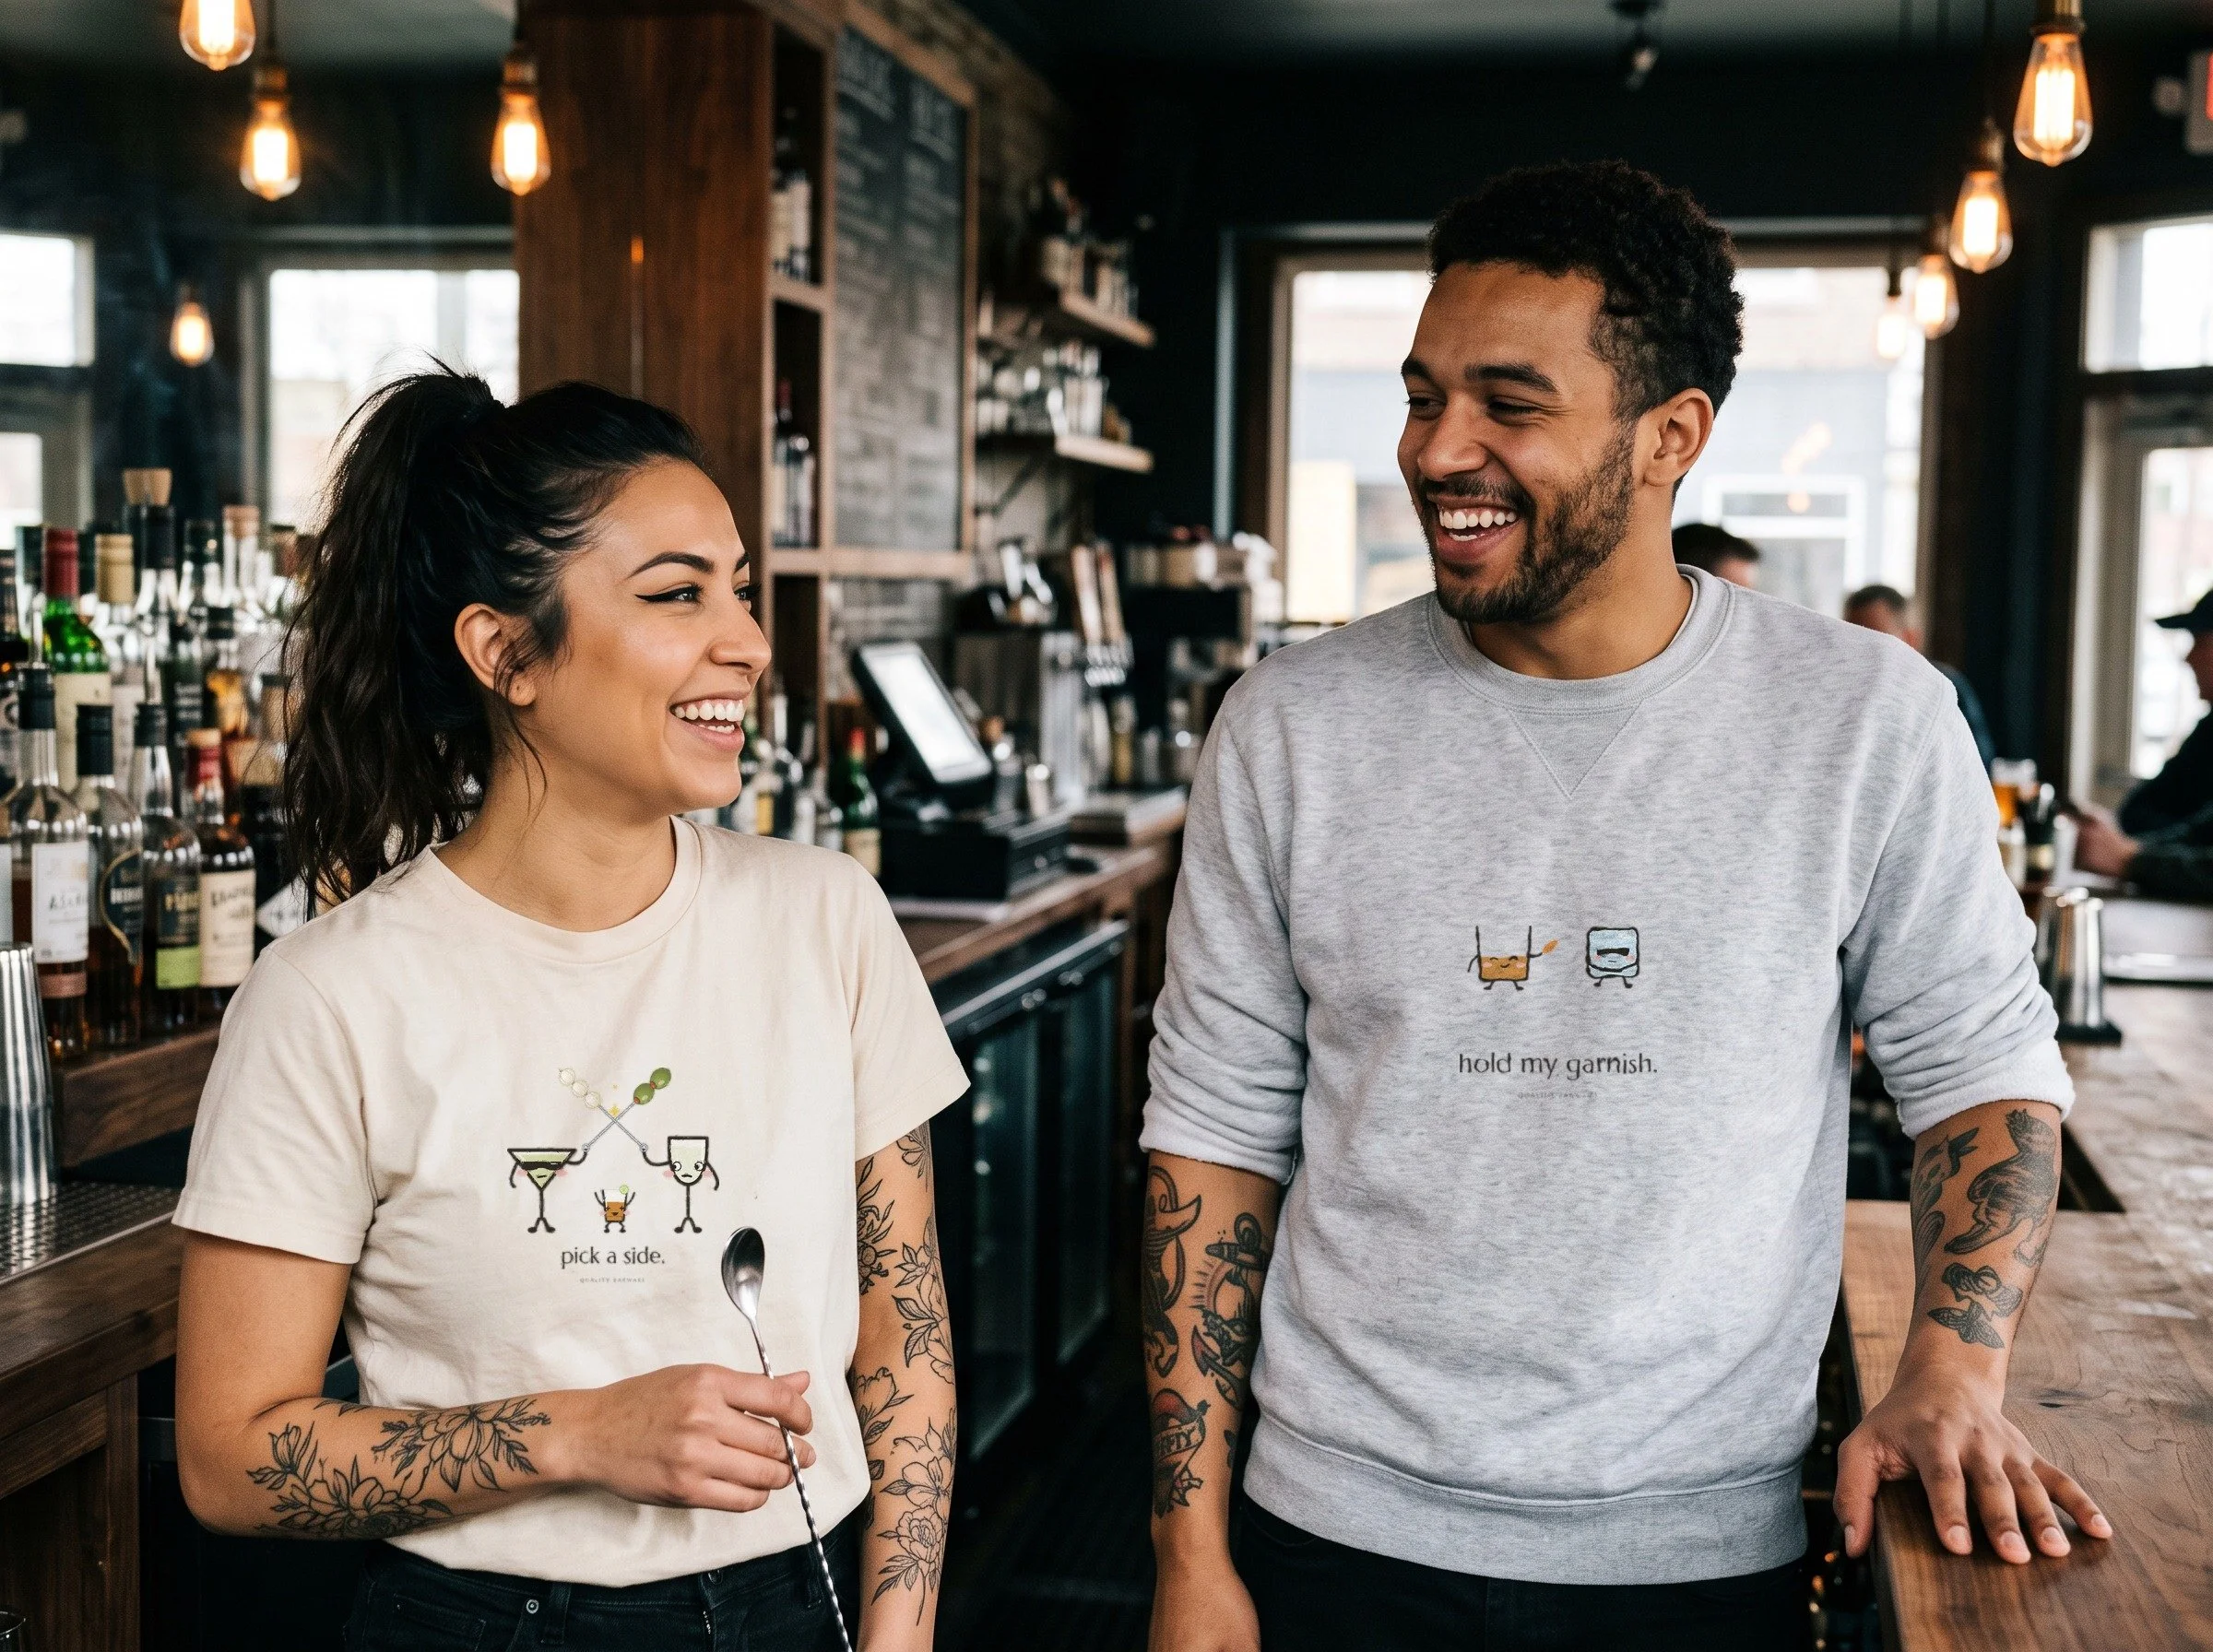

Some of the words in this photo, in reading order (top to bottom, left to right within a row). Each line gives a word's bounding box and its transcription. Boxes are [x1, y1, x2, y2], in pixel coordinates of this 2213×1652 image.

[1459, 1052, 1511, 1073] hold
[1521, 1056, 1558, 1080] my
[1566, 1052, 1658, 1080] garnish.
[560, 1245, 599, 1269] pick
[606, 1250, 616, 1264] a
[622, 1245, 665, 1264] side.
